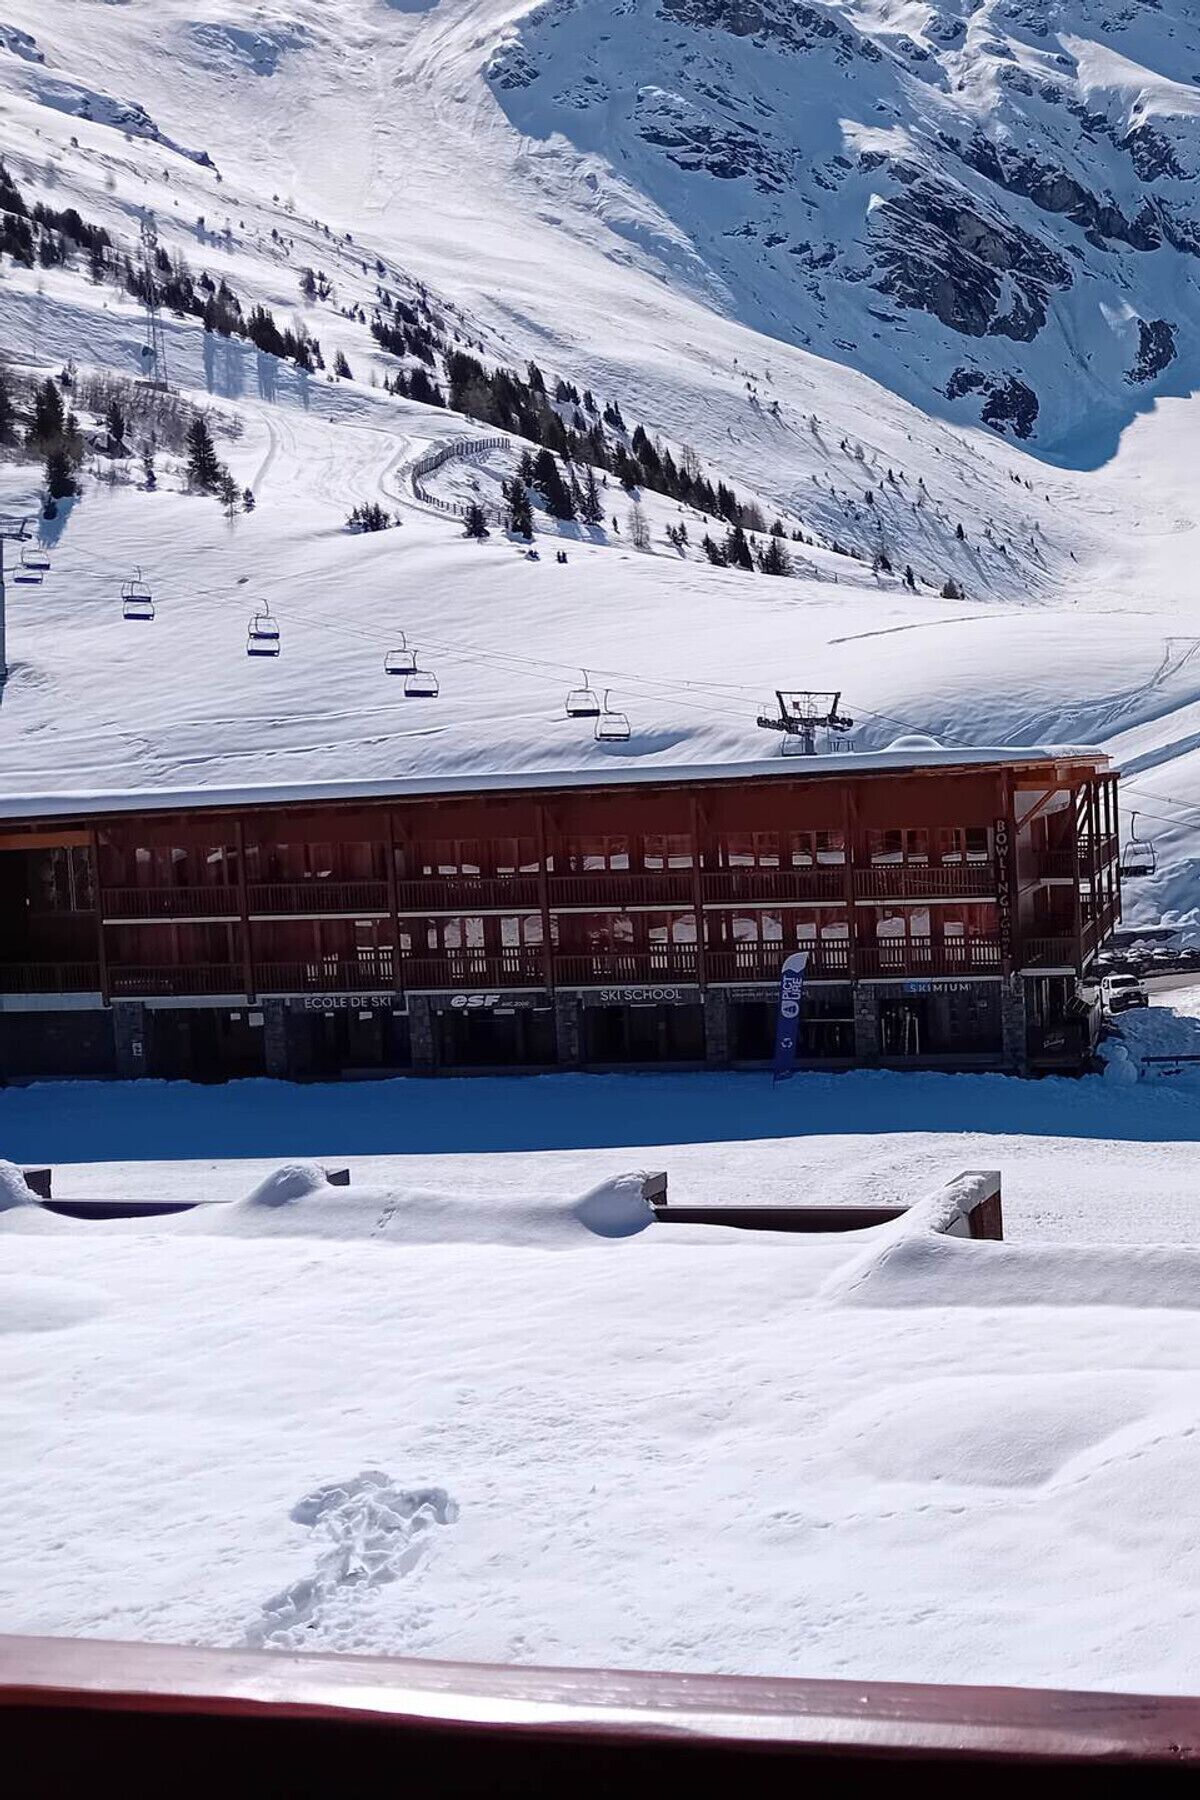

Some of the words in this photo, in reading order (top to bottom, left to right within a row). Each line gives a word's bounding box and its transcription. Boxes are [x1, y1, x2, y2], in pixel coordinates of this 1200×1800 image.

[996, 820, 1009, 907] BOWLING
[910, 982, 972, 993] SKIMIUM
[601, 989, 621, 1001] SKI
[624, 988, 682, 1000] SCHOOL
[304, 998, 348, 1009] ECOLE
[351, 996, 369, 1008] DE
[371, 996, 392, 1007] SKI
